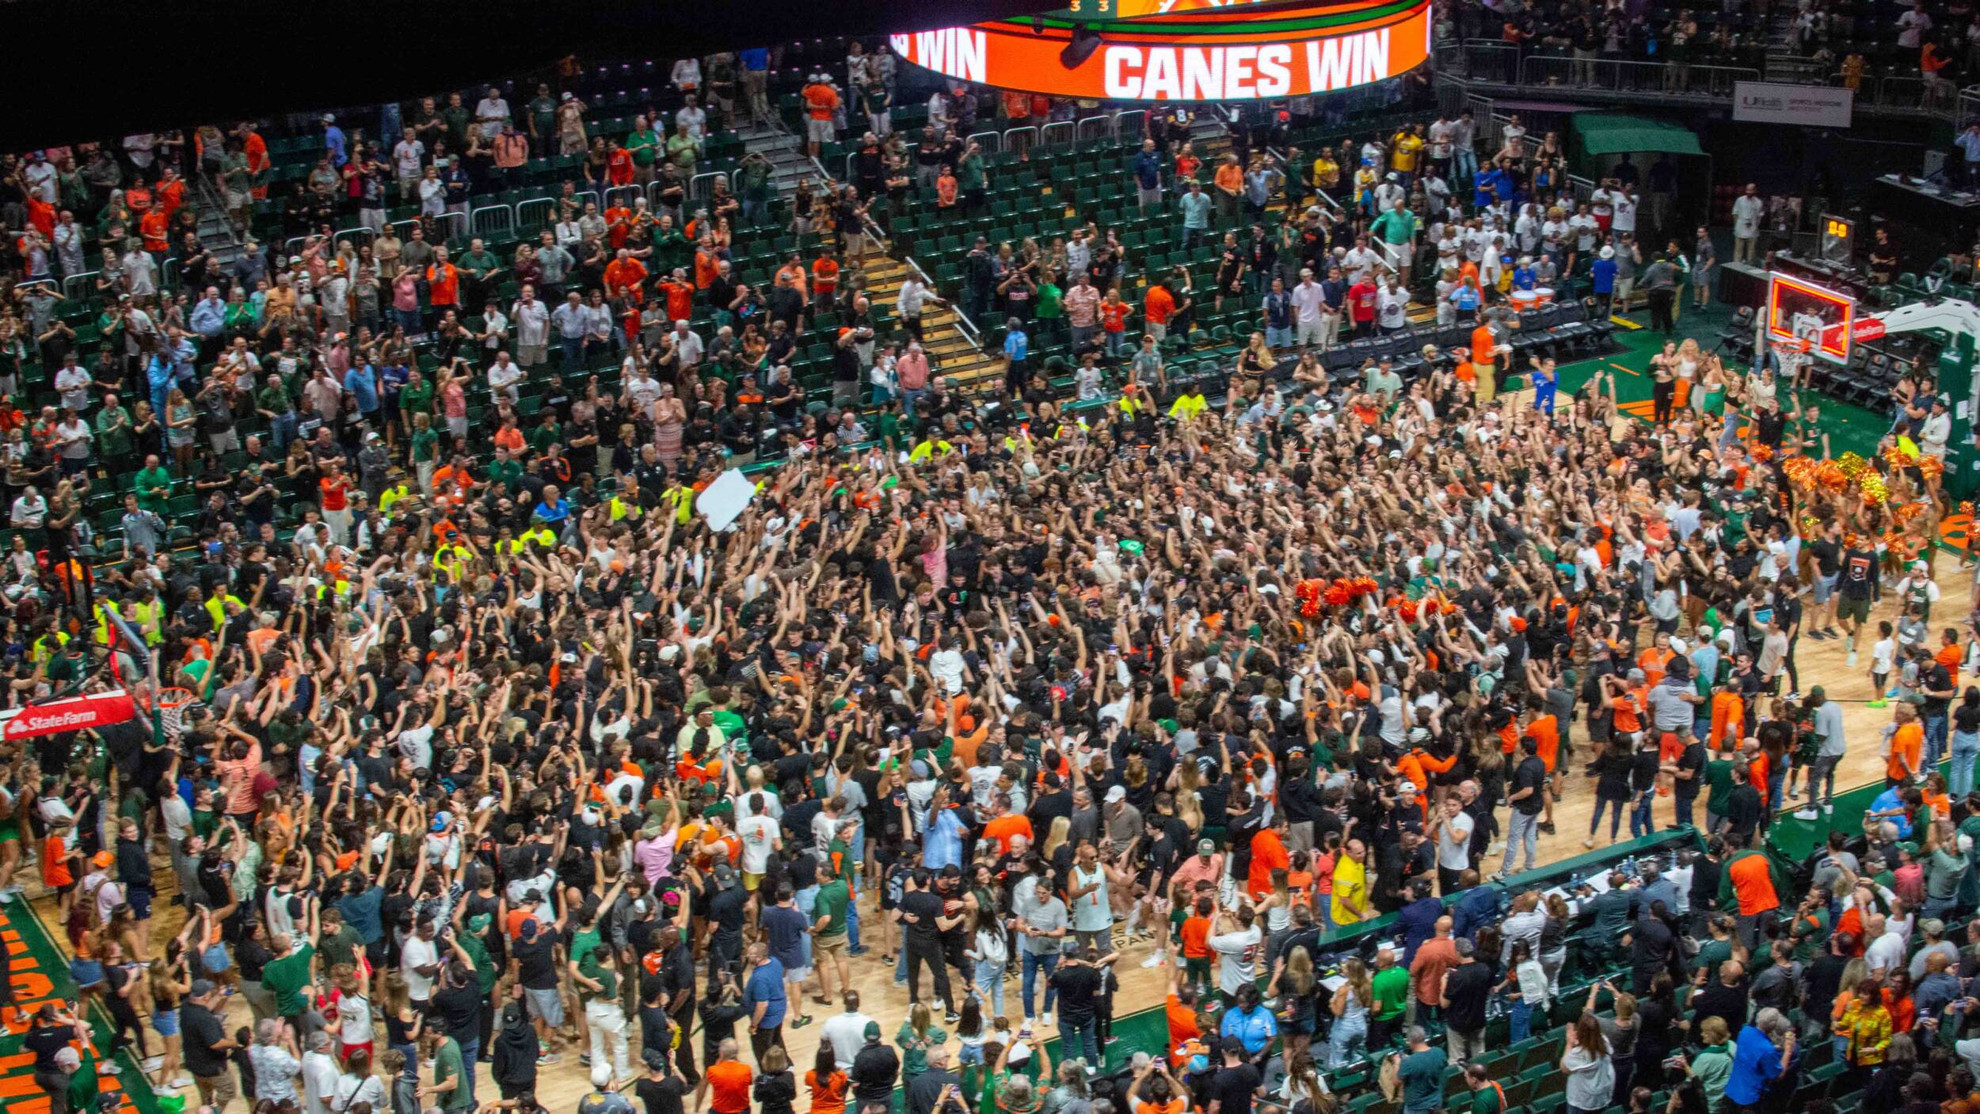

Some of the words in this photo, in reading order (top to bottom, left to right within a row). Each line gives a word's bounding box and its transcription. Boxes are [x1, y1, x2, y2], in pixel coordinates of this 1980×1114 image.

[916, 27, 986, 83] WIN
[1104, 45, 1291, 100] CANES
[1306, 28, 1389, 94] WIN
